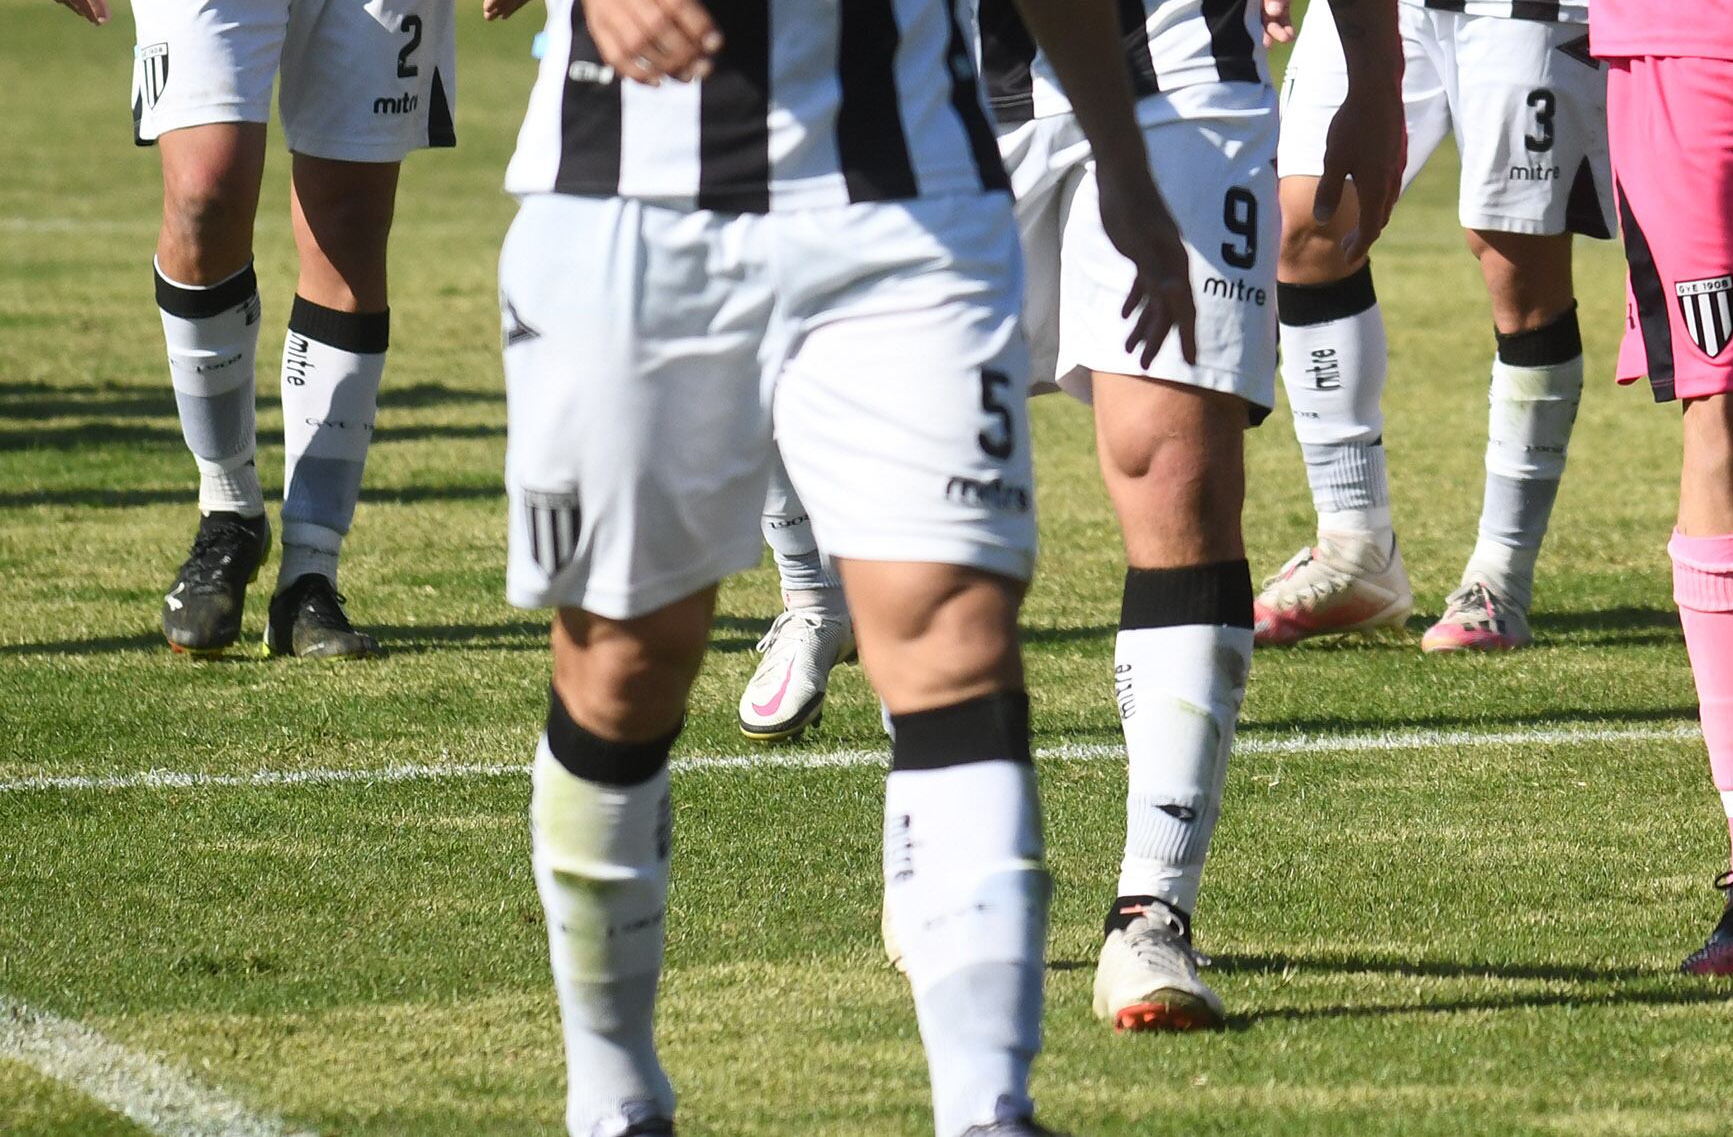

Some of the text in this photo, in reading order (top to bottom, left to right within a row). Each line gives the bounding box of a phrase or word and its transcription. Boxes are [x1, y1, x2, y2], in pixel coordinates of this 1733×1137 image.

[397, 14, 422, 79] 2
[1524, 88, 1556, 153] 3
[1509, 163, 1561, 181] mitre
[1221, 185, 1258, 271] 9
[1203, 277, 1267, 307] mitre
[1702, 278, 1729, 291] 1908
[286, 332, 316, 387] mitre
[1305, 347, 1342, 390] mitre
[978, 365, 1015, 461] 5
[1115, 663, 1136, 720] mitre
